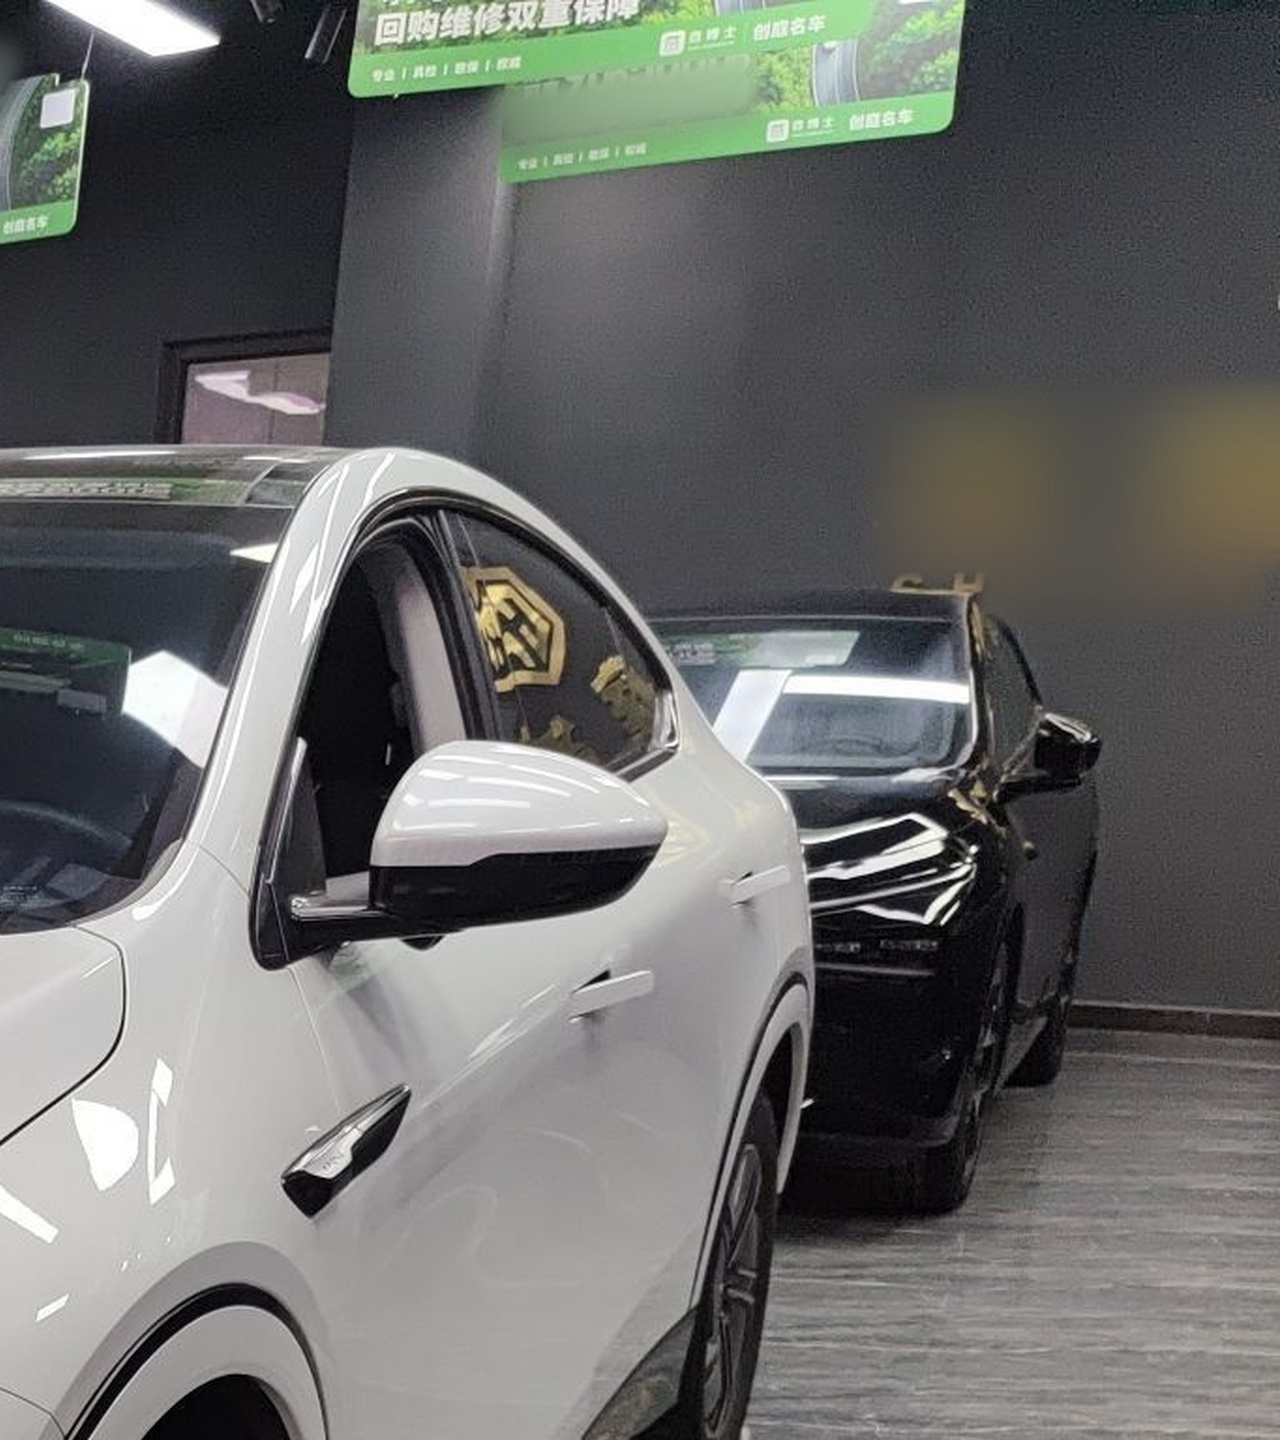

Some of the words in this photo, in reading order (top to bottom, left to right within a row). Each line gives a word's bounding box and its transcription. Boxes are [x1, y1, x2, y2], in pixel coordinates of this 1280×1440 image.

[373, 0, 640, 46] 回购维修双重保障
